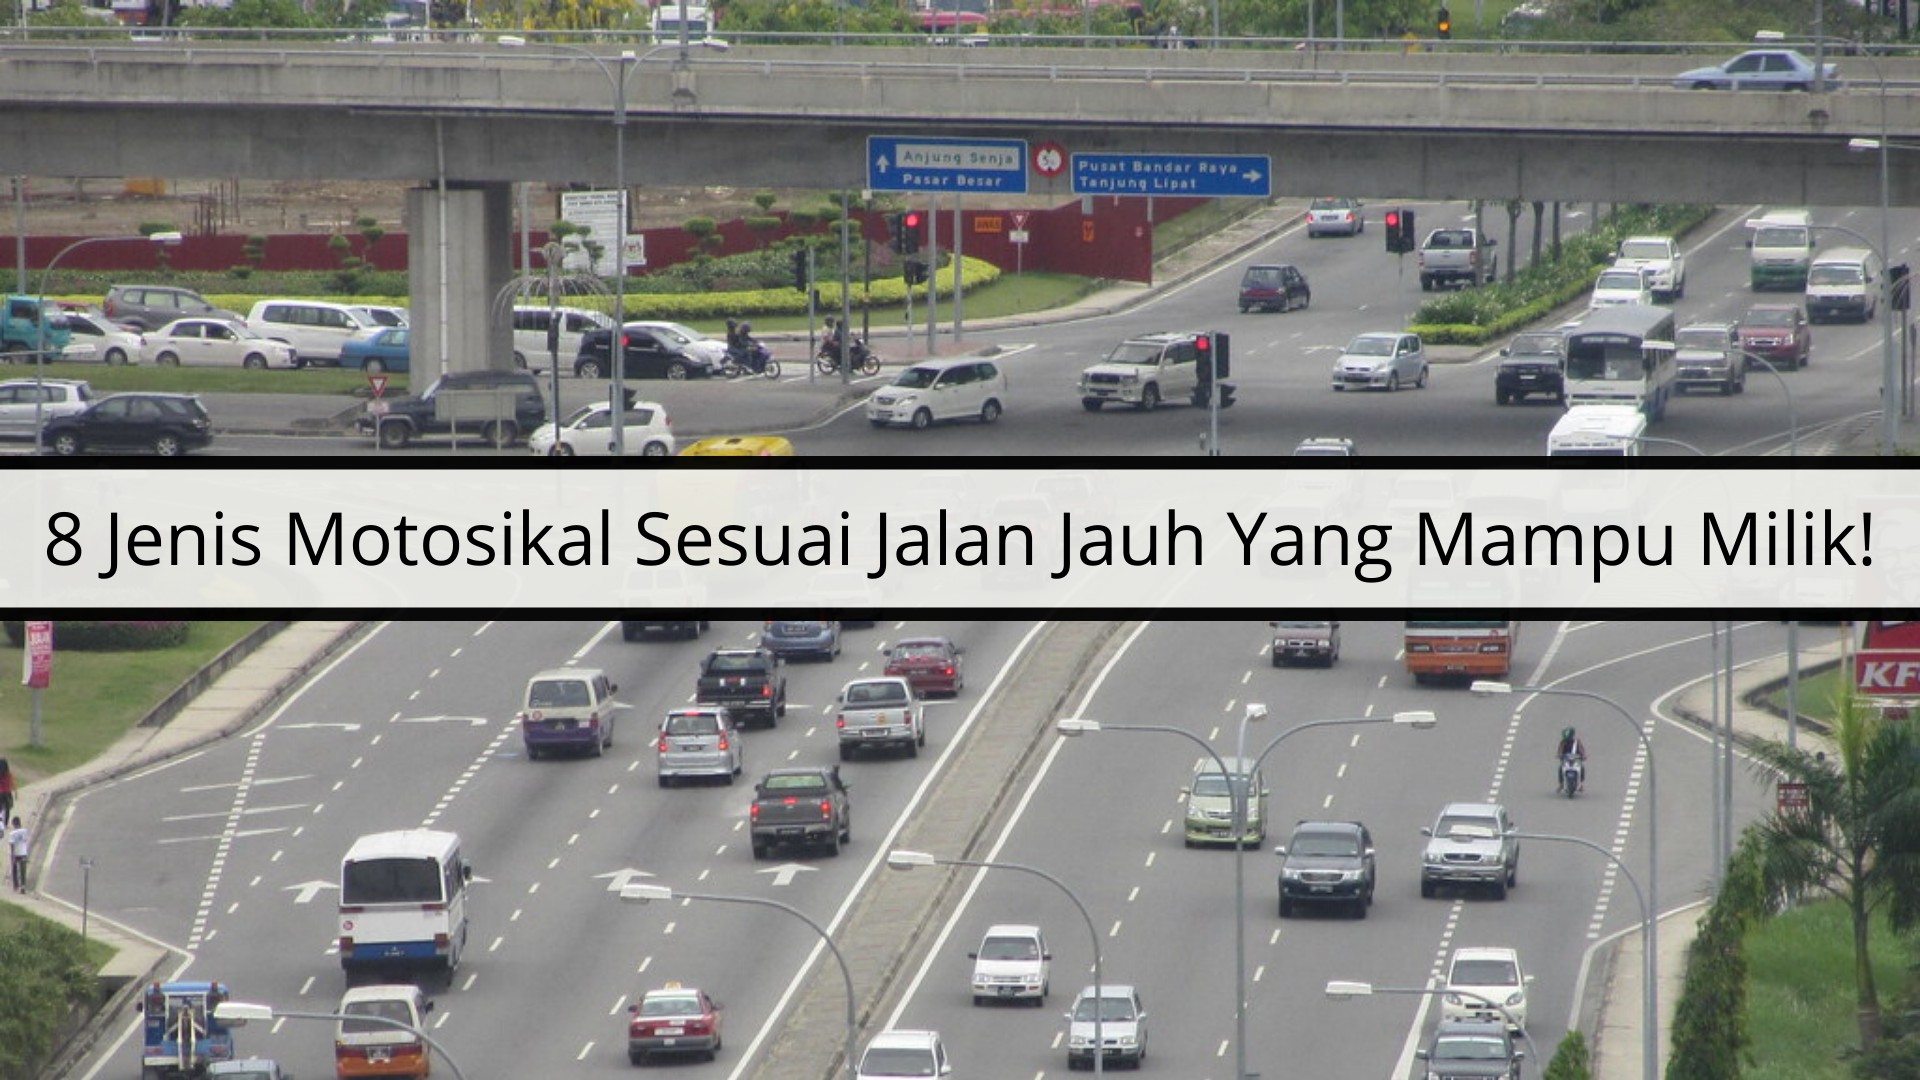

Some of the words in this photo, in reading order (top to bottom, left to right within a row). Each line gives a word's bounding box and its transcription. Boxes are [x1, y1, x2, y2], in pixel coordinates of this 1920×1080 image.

[903, 151, 961, 165] Anjung
[969, 152, 1014, 165] Senja
[1079, 160, 1126, 172] Pusat
[1132, 161, 1192, 173] Bandar
[1199, 162, 1238, 175] Raya
[903, 173, 949, 185] Pasar
[957, 174, 1003, 187] Besar
[1079, 177, 1147, 191] Tanjung
[1154, 177, 1197, 190] Lipat
[1860, 661, 1920, 688] KF
